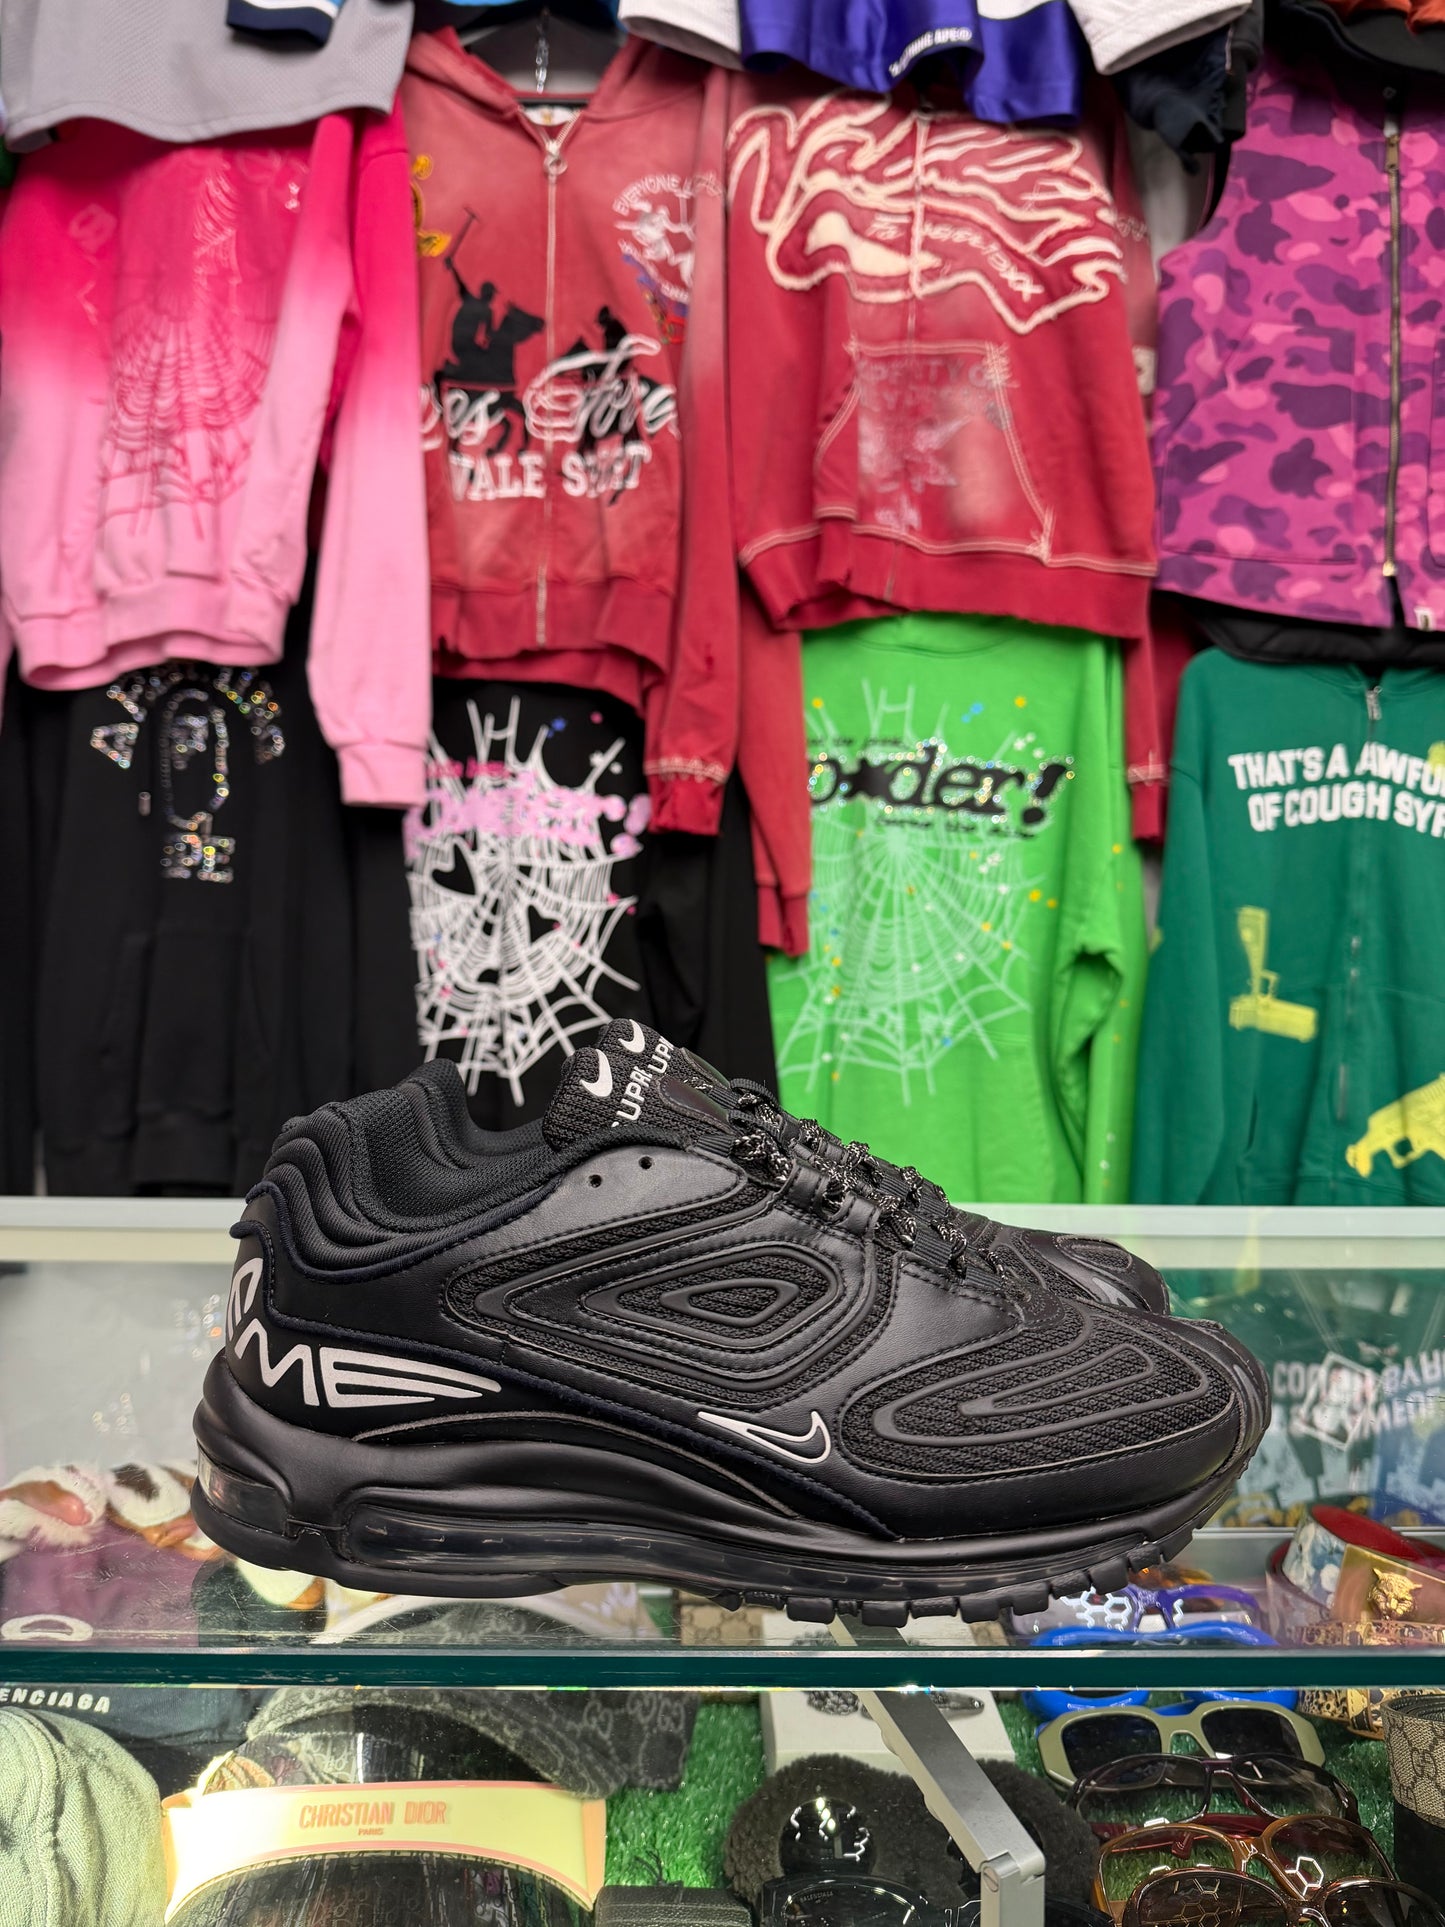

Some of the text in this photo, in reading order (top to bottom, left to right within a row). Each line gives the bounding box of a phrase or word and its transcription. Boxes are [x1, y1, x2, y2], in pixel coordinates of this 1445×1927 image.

[449, 450, 547, 500] VALE
[1227, 741, 1445, 798] THAT'S A AWFU
[1248, 792, 1283, 832] OF
[1284, 780, 1391, 828] COUGH
[300, 1801, 447, 1829] CHRISTIAN DIOR
